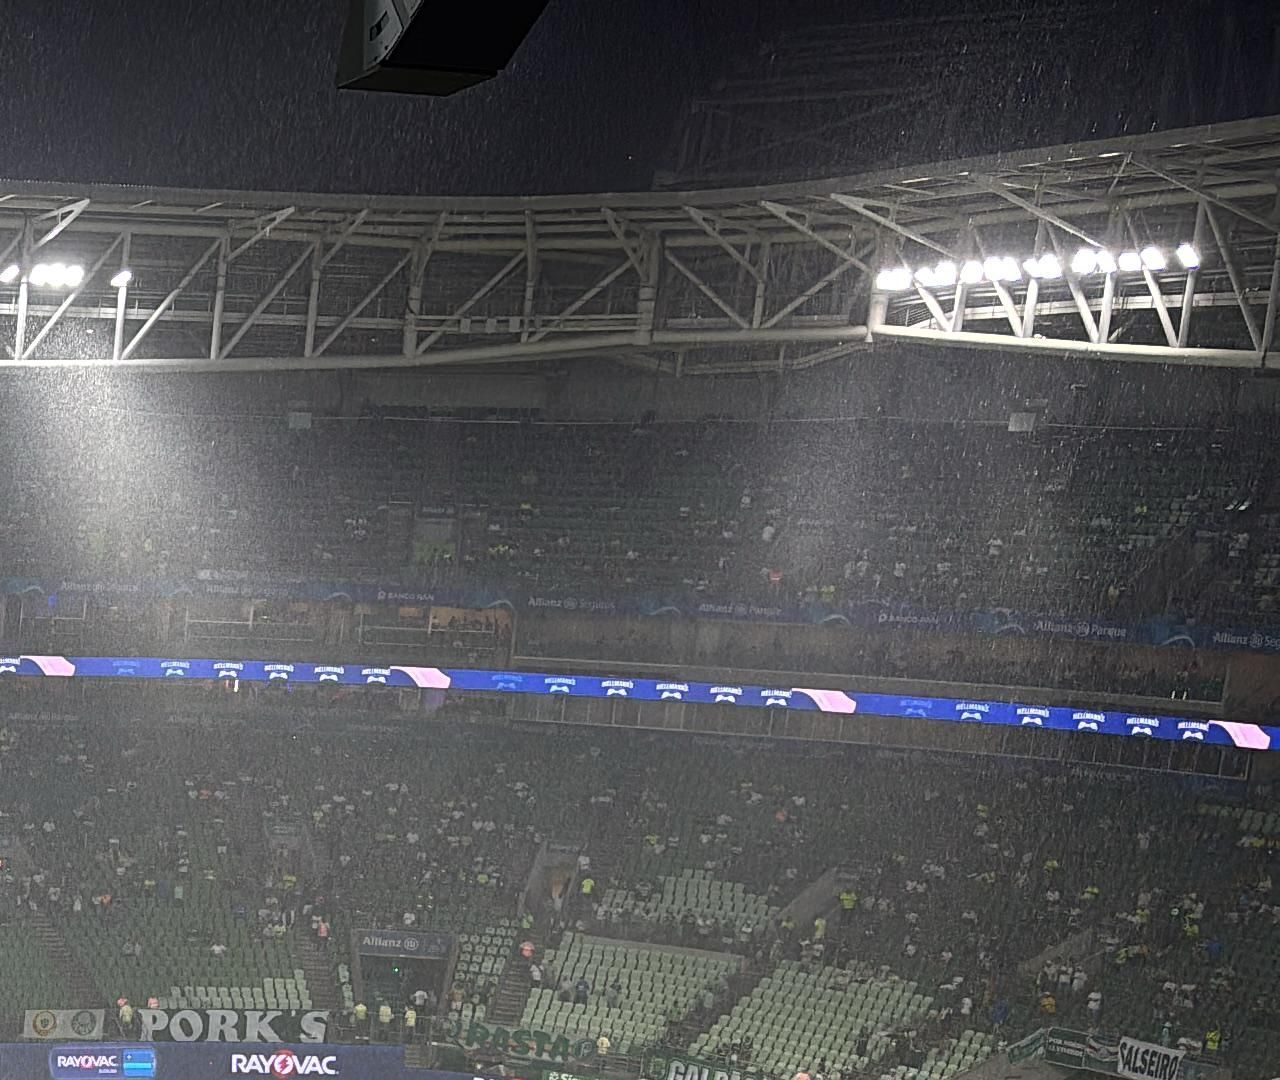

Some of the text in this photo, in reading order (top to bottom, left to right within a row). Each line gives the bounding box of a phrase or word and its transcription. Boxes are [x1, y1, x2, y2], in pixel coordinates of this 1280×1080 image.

[1037, 620, 1073, 633] Allianz
[1215, 631, 1248, 645] Allianz
[362, 936, 401, 948] Allianz
[139, 1009, 329, 1043] PORK'S
[57, 1055, 117, 1069] RAYOVAC
[231, 1053, 337, 1075] RAYOVAC
